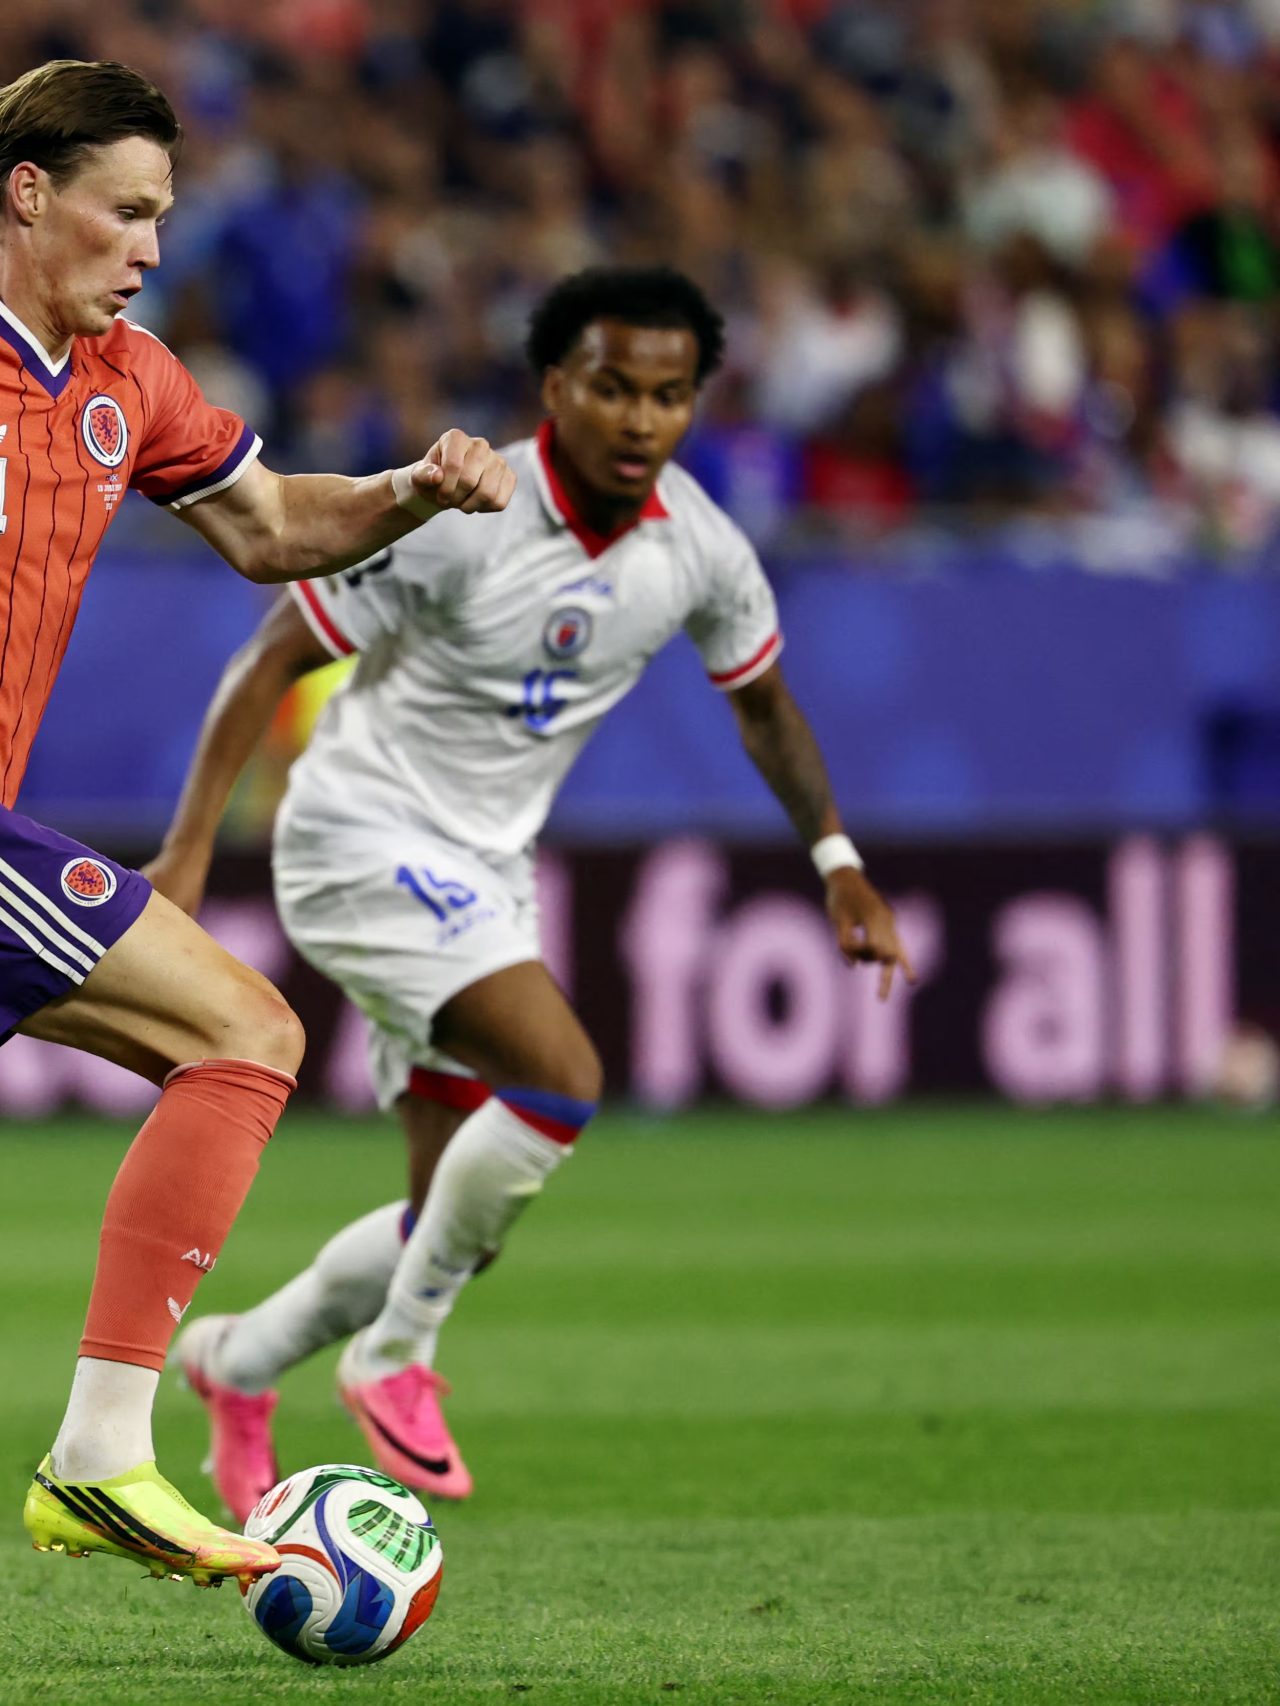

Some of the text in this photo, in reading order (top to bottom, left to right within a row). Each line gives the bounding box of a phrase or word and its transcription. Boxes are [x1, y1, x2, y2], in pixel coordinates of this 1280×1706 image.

[396, 865, 477, 922] 15
[622, 838, 940, 1108] for
[982, 835, 1233, 1104] all
[180, 1247, 217, 1273] AL
